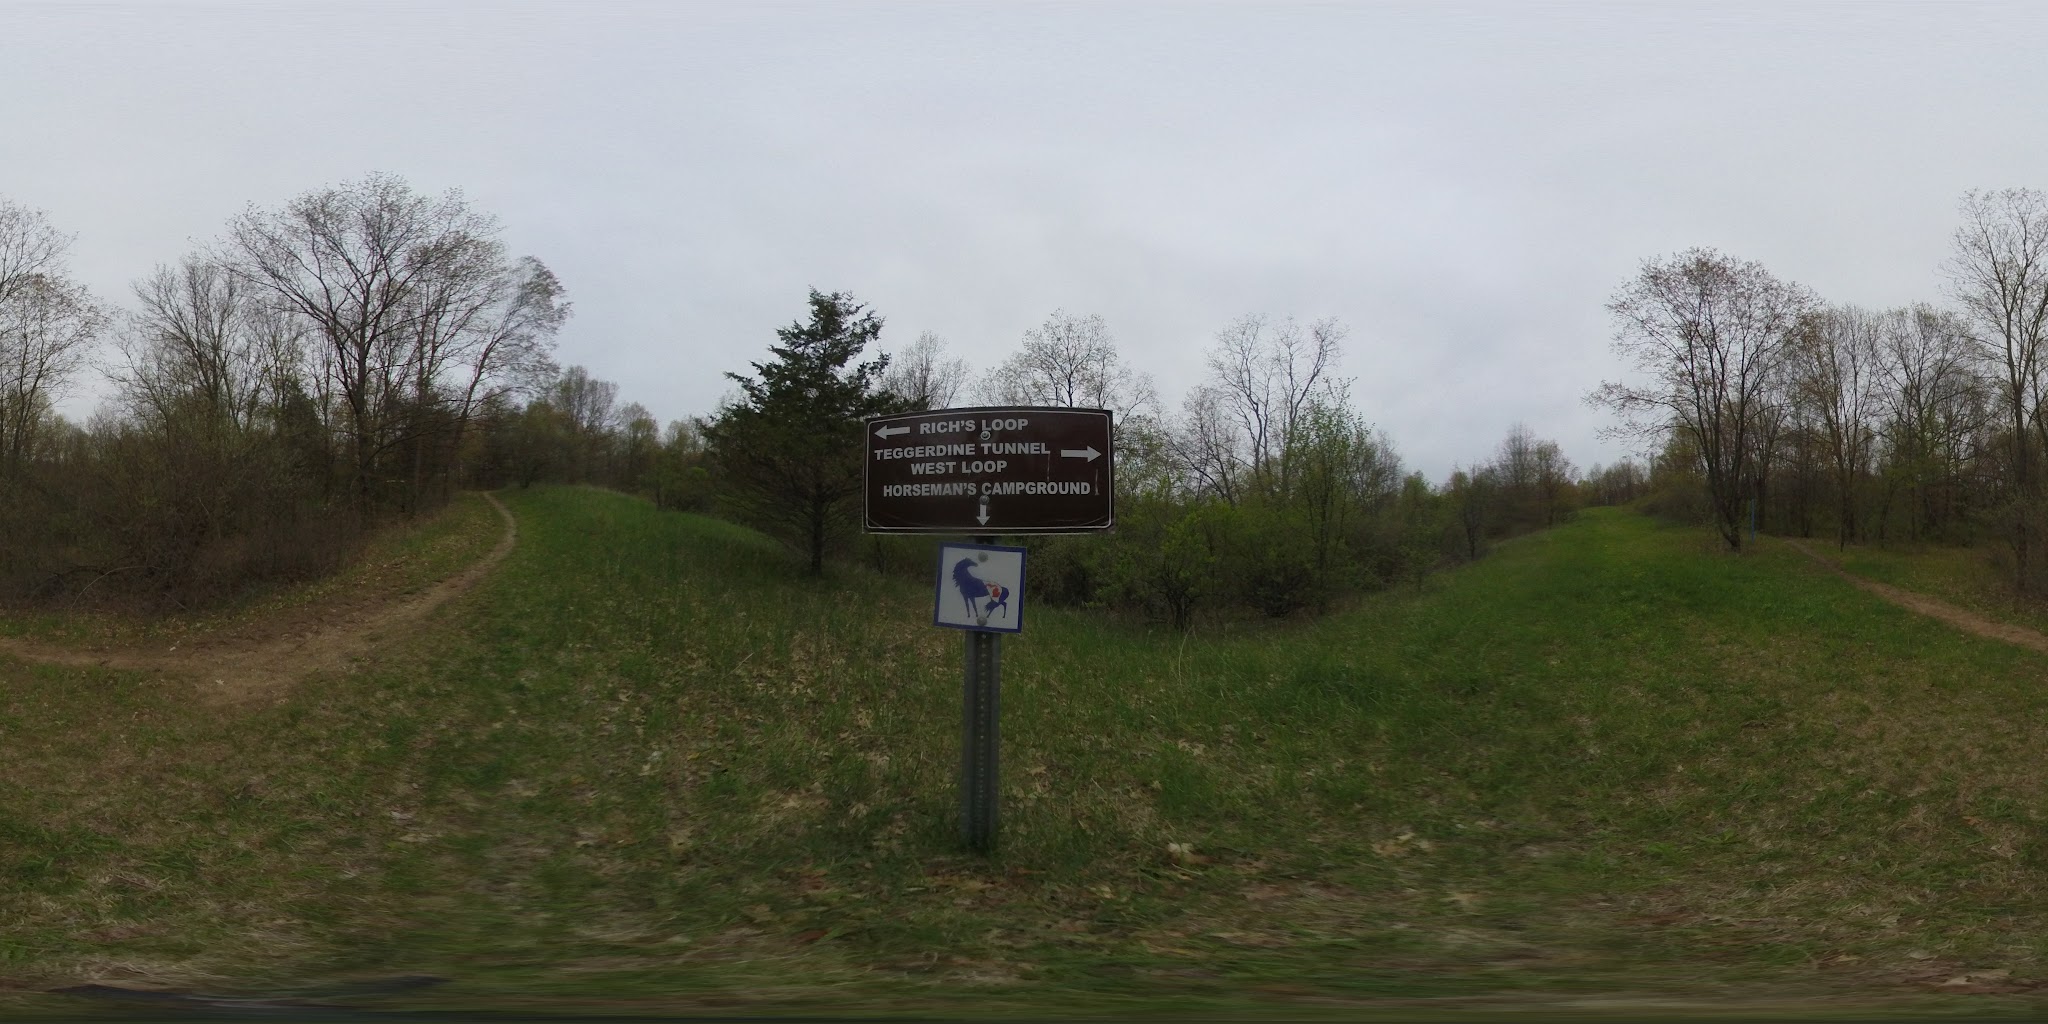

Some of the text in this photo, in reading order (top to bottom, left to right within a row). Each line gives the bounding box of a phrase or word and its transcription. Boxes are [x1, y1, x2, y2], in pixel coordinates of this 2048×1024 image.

[919, 418, 1029, 435] RICH'S LOOP
[874, 442, 1051, 461] TEGGERDINE TUNNEL
[910, 460, 1008, 475] WEST LOOP
[883, 481, 1091, 497] HORSEMAN'S CAMPGROUND
